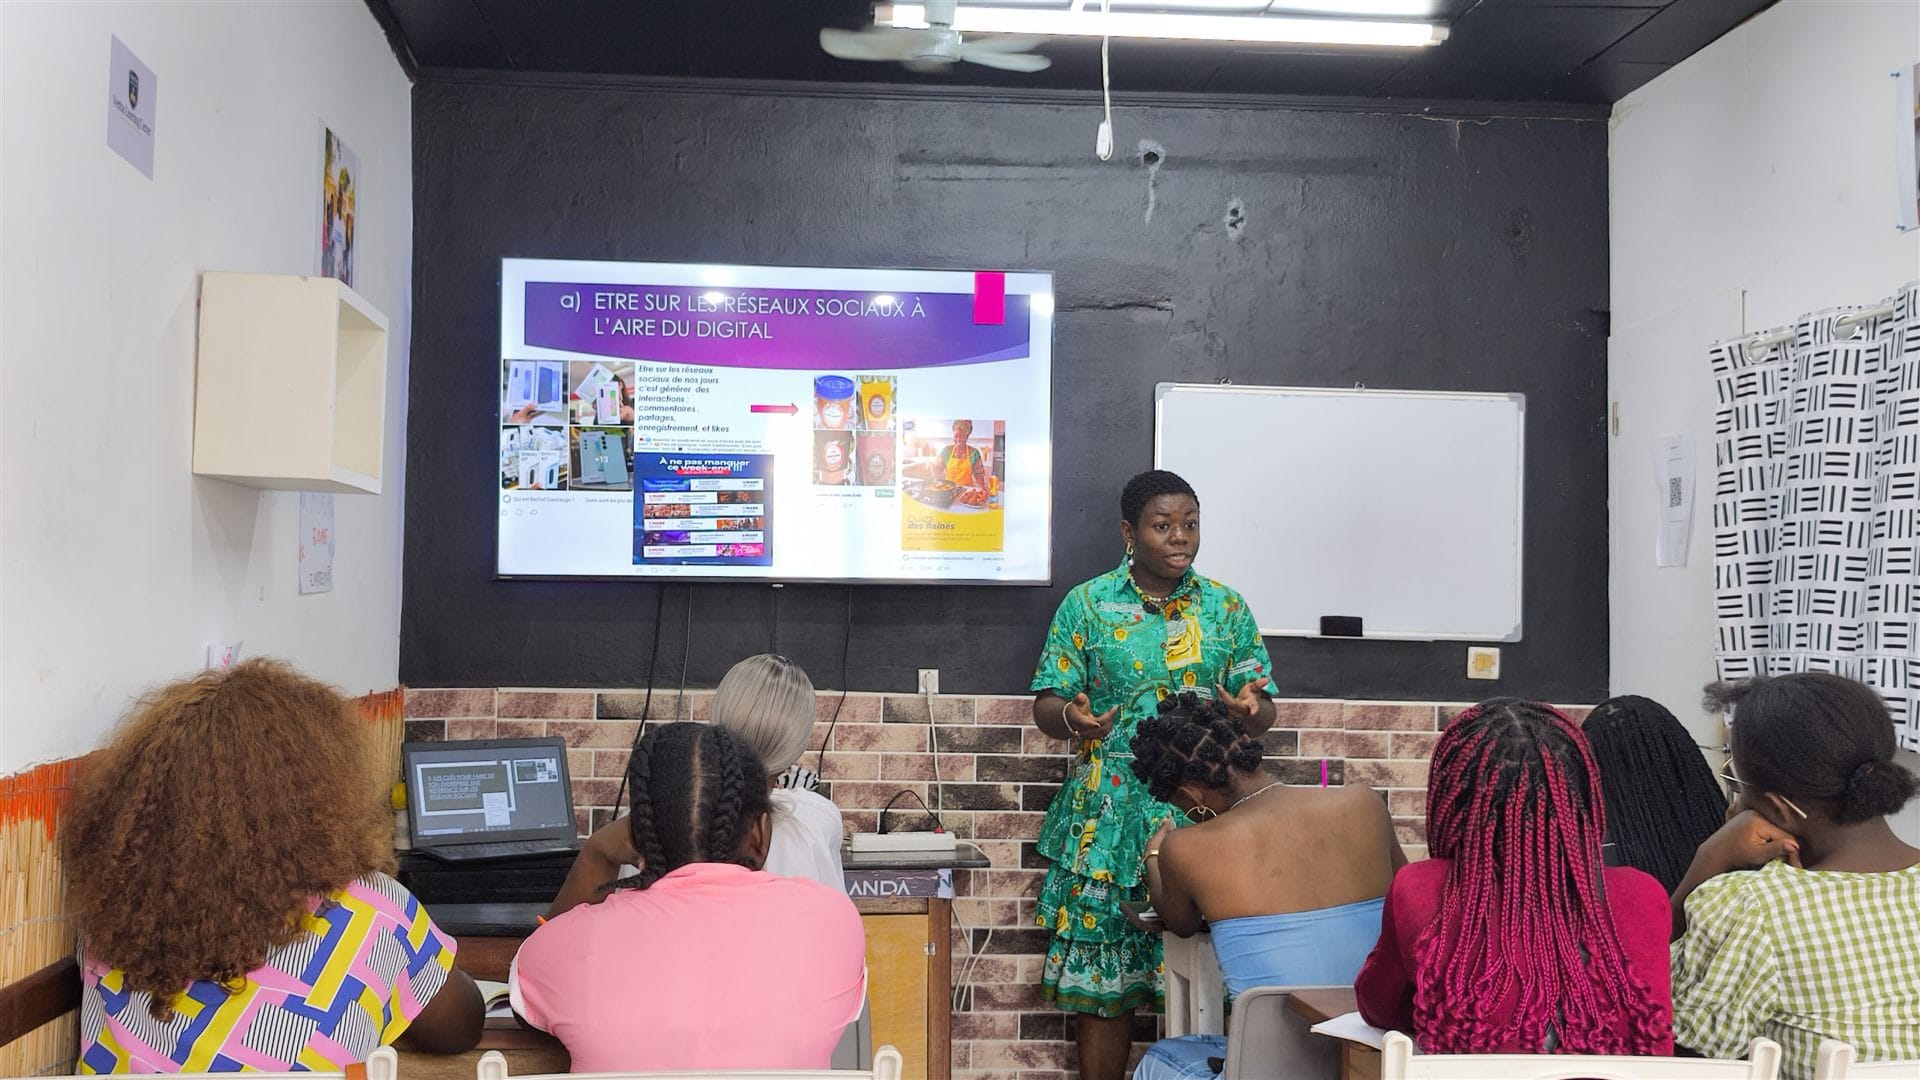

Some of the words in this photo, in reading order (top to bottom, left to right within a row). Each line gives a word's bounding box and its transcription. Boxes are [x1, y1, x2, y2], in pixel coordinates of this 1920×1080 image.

[560, 291, 581, 313] a)
[595, 292, 639, 310] ETRE
[644, 293, 680, 312] SUR
[688, 295, 718, 313] LES
[724, 292, 810, 315] RÉSEAUX
[815, 297, 904, 317] SOCIAUX
[911, 297, 926, 318] À
[662, 320, 690, 337] DU
[697, 320, 773, 339] DIGITAL
[669, 365, 680, 373] les
[681, 366, 714, 374] réseaux
[699, 377, 719, 385] jours
[659, 385, 691, 394] générer
[638, 395, 685, 403] interactions
[638, 405, 696, 413] commentaires
